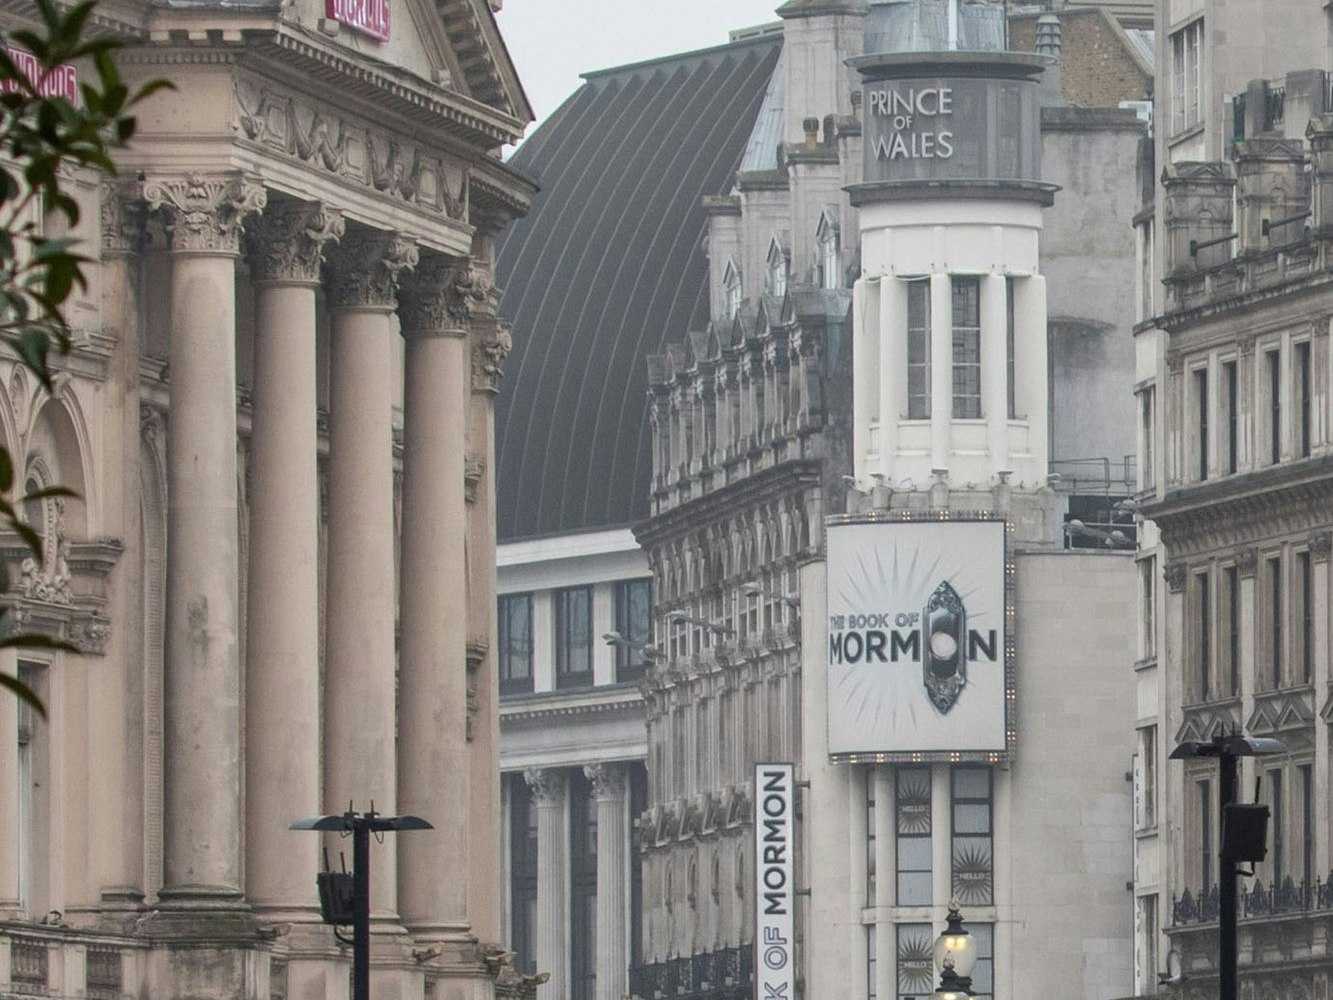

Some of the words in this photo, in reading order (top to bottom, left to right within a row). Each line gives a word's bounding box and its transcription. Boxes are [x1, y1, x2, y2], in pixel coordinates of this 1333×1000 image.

[870, 88, 953, 115] PRINCE
[893, 116, 913, 130] OF
[871, 131, 953, 159] WALES
[830, 615, 845, 630] THE
[849, 613, 889, 629] BOOK
[895, 612, 919, 628] OF
[763, 771, 788, 916] MORMON
[764, 926, 789, 971] OF
